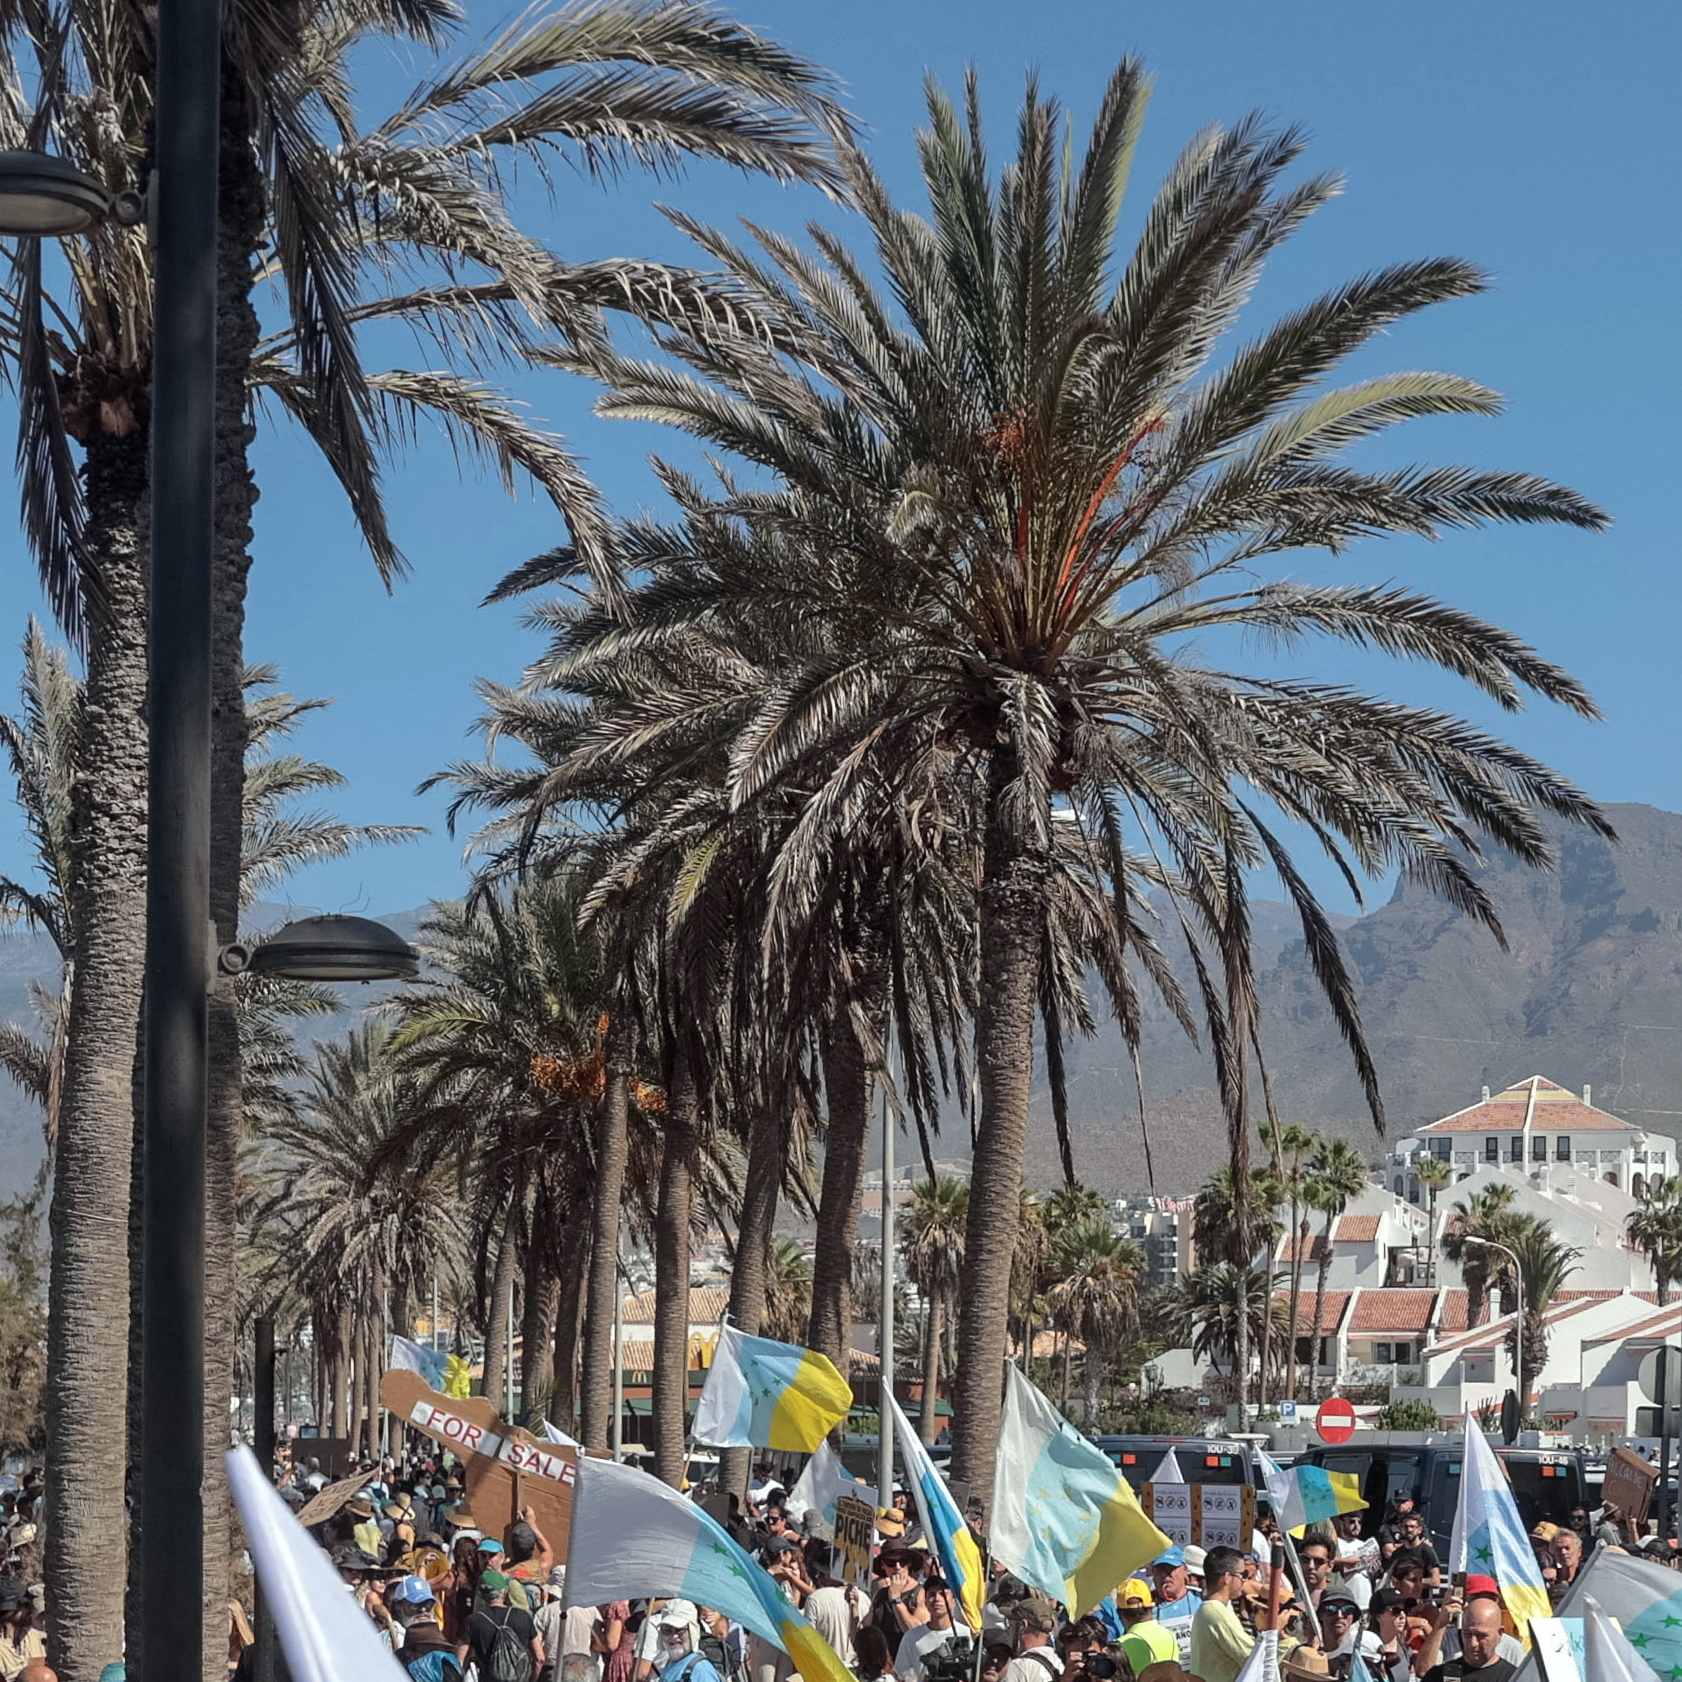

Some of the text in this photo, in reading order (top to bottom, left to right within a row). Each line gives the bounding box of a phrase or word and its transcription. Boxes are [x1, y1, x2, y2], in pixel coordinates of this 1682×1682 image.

[1283, 1403, 1293, 1415] P
[426, 1408, 575, 1487] FOR SALE
[835, 1513, 872, 1546] PICHE
